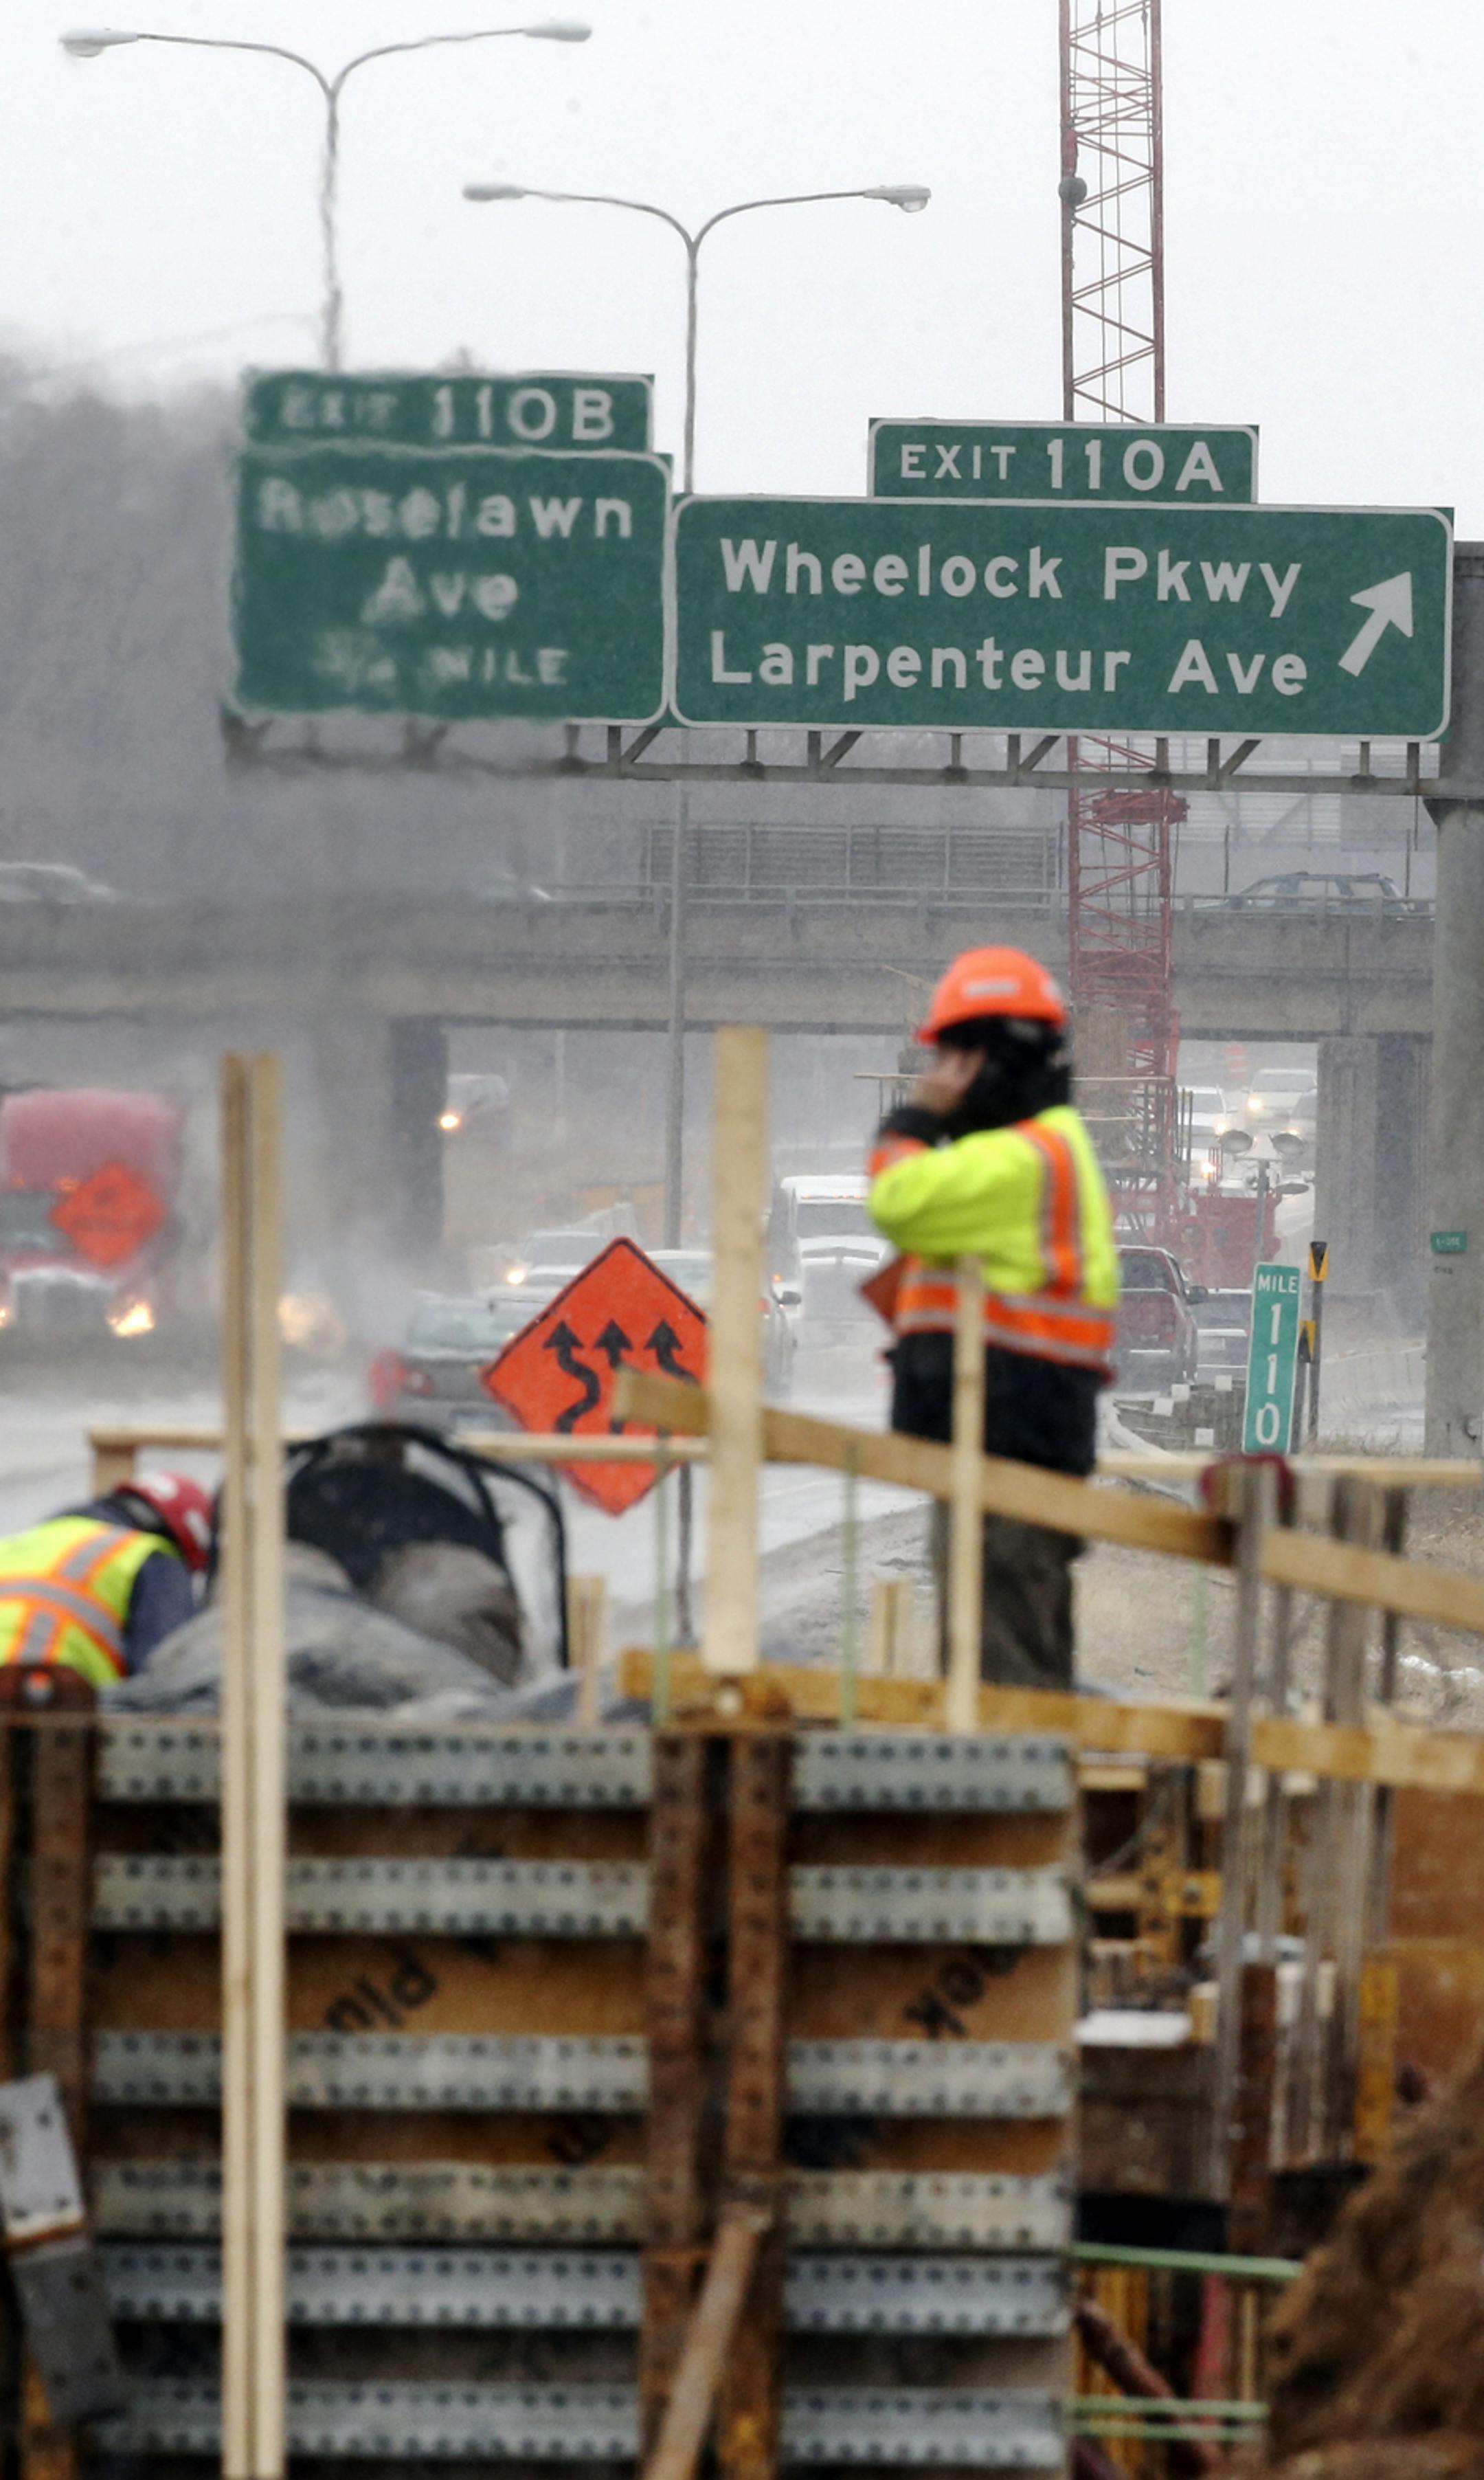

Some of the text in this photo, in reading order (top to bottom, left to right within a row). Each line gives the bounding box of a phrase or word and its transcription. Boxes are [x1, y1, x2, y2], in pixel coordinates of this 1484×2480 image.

[431, 385, 614, 440] 110B
[900, 438, 1224, 492] EXIT 110A
[256, 477, 632, 539] Roselawn
[361, 554, 519, 621] Ave
[719, 537, 1301, 618] Wheelock Pkwy
[427, 646, 570, 686] MILE
[710, 629, 1307, 703] Larpenteur Ave
[1257, 1273, 1298, 1294] MILE
